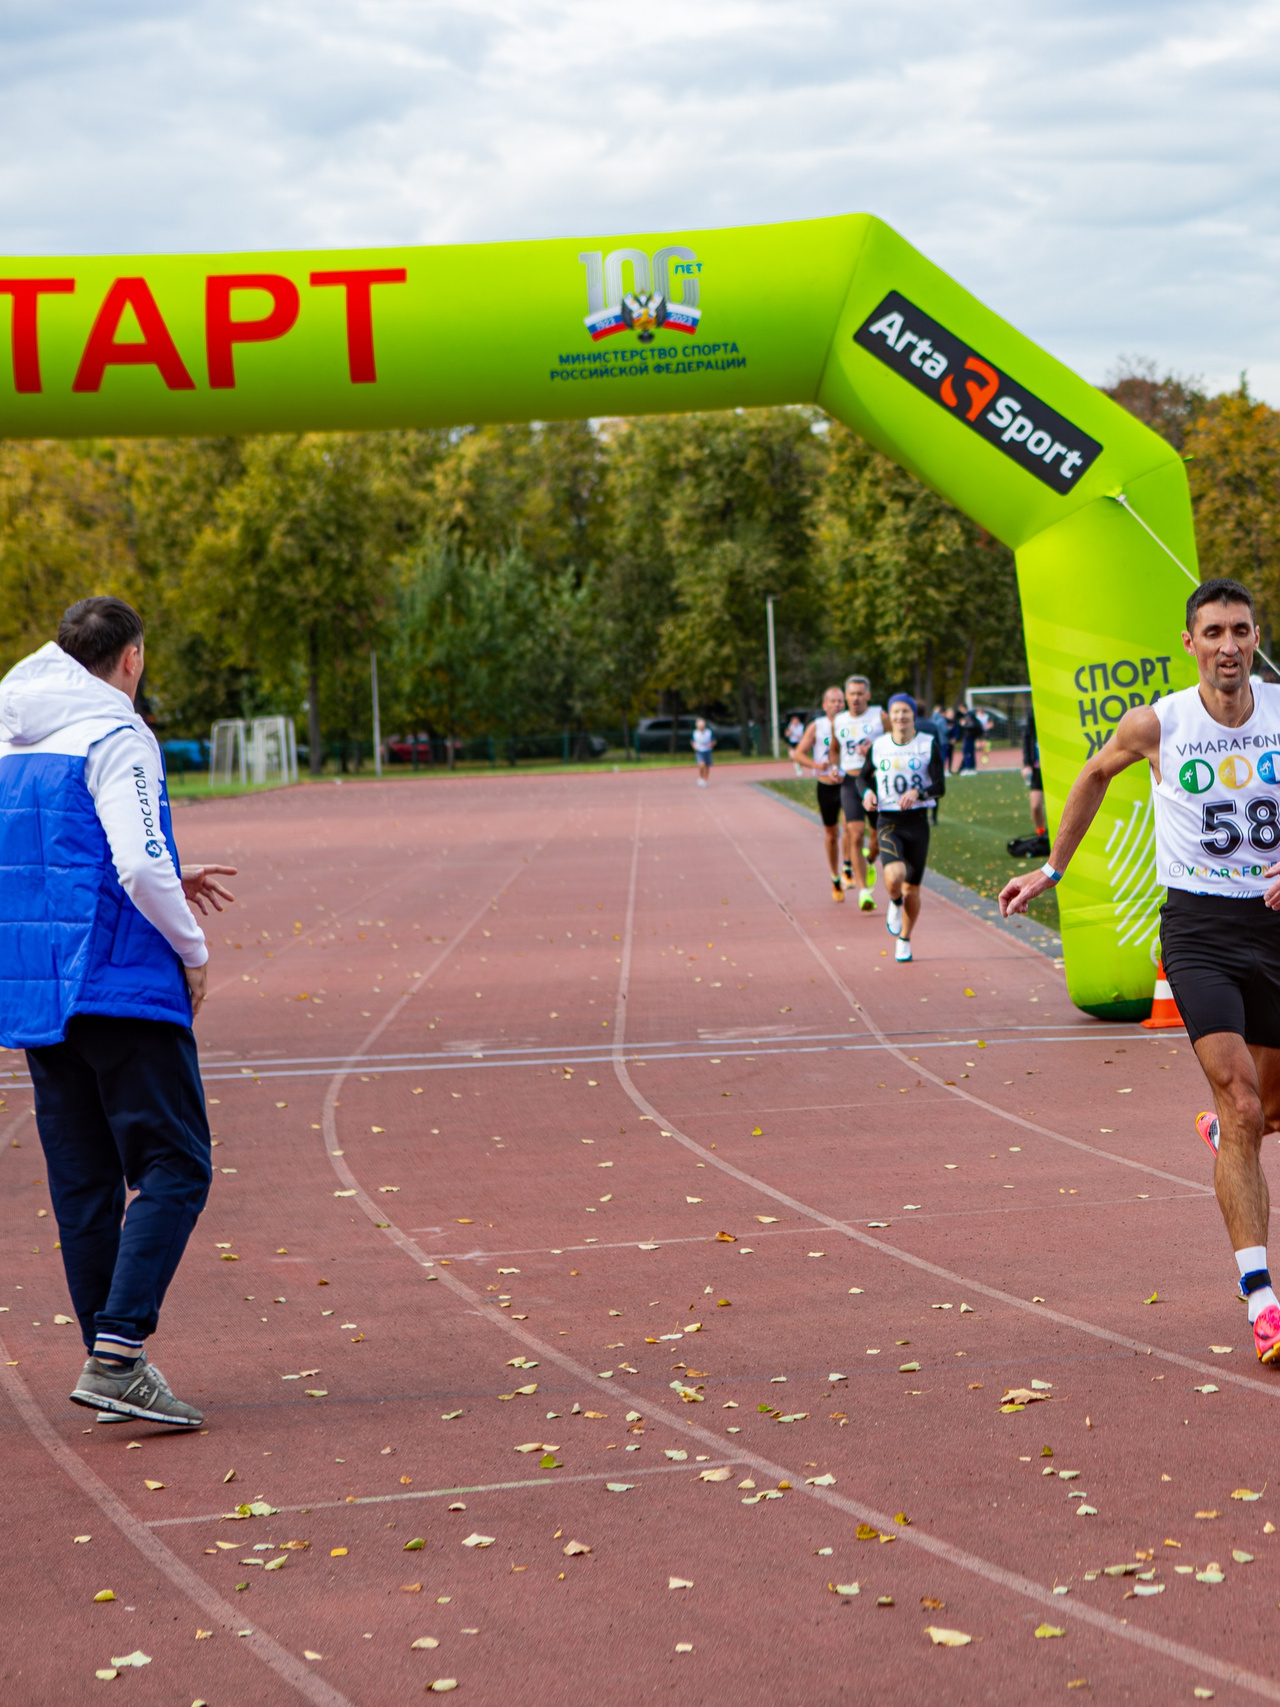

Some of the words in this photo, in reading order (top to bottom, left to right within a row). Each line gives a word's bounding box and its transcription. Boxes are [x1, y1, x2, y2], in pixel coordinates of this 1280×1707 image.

[550, 362, 649, 381] РОССИЙСКОЙ
[653, 357, 746, 375] ФЕДЕРАЦИИ
[558, 346, 678, 366] МИНИСТЕРСТВО
[682, 342, 739, 358] СПОРТА
[868, 311, 949, 380] Arta
[986, 396, 1083, 479] Sport
[1074, 656, 1171, 694] СПОРТ
[133, 766, 155, 837] РОСАТОМ
